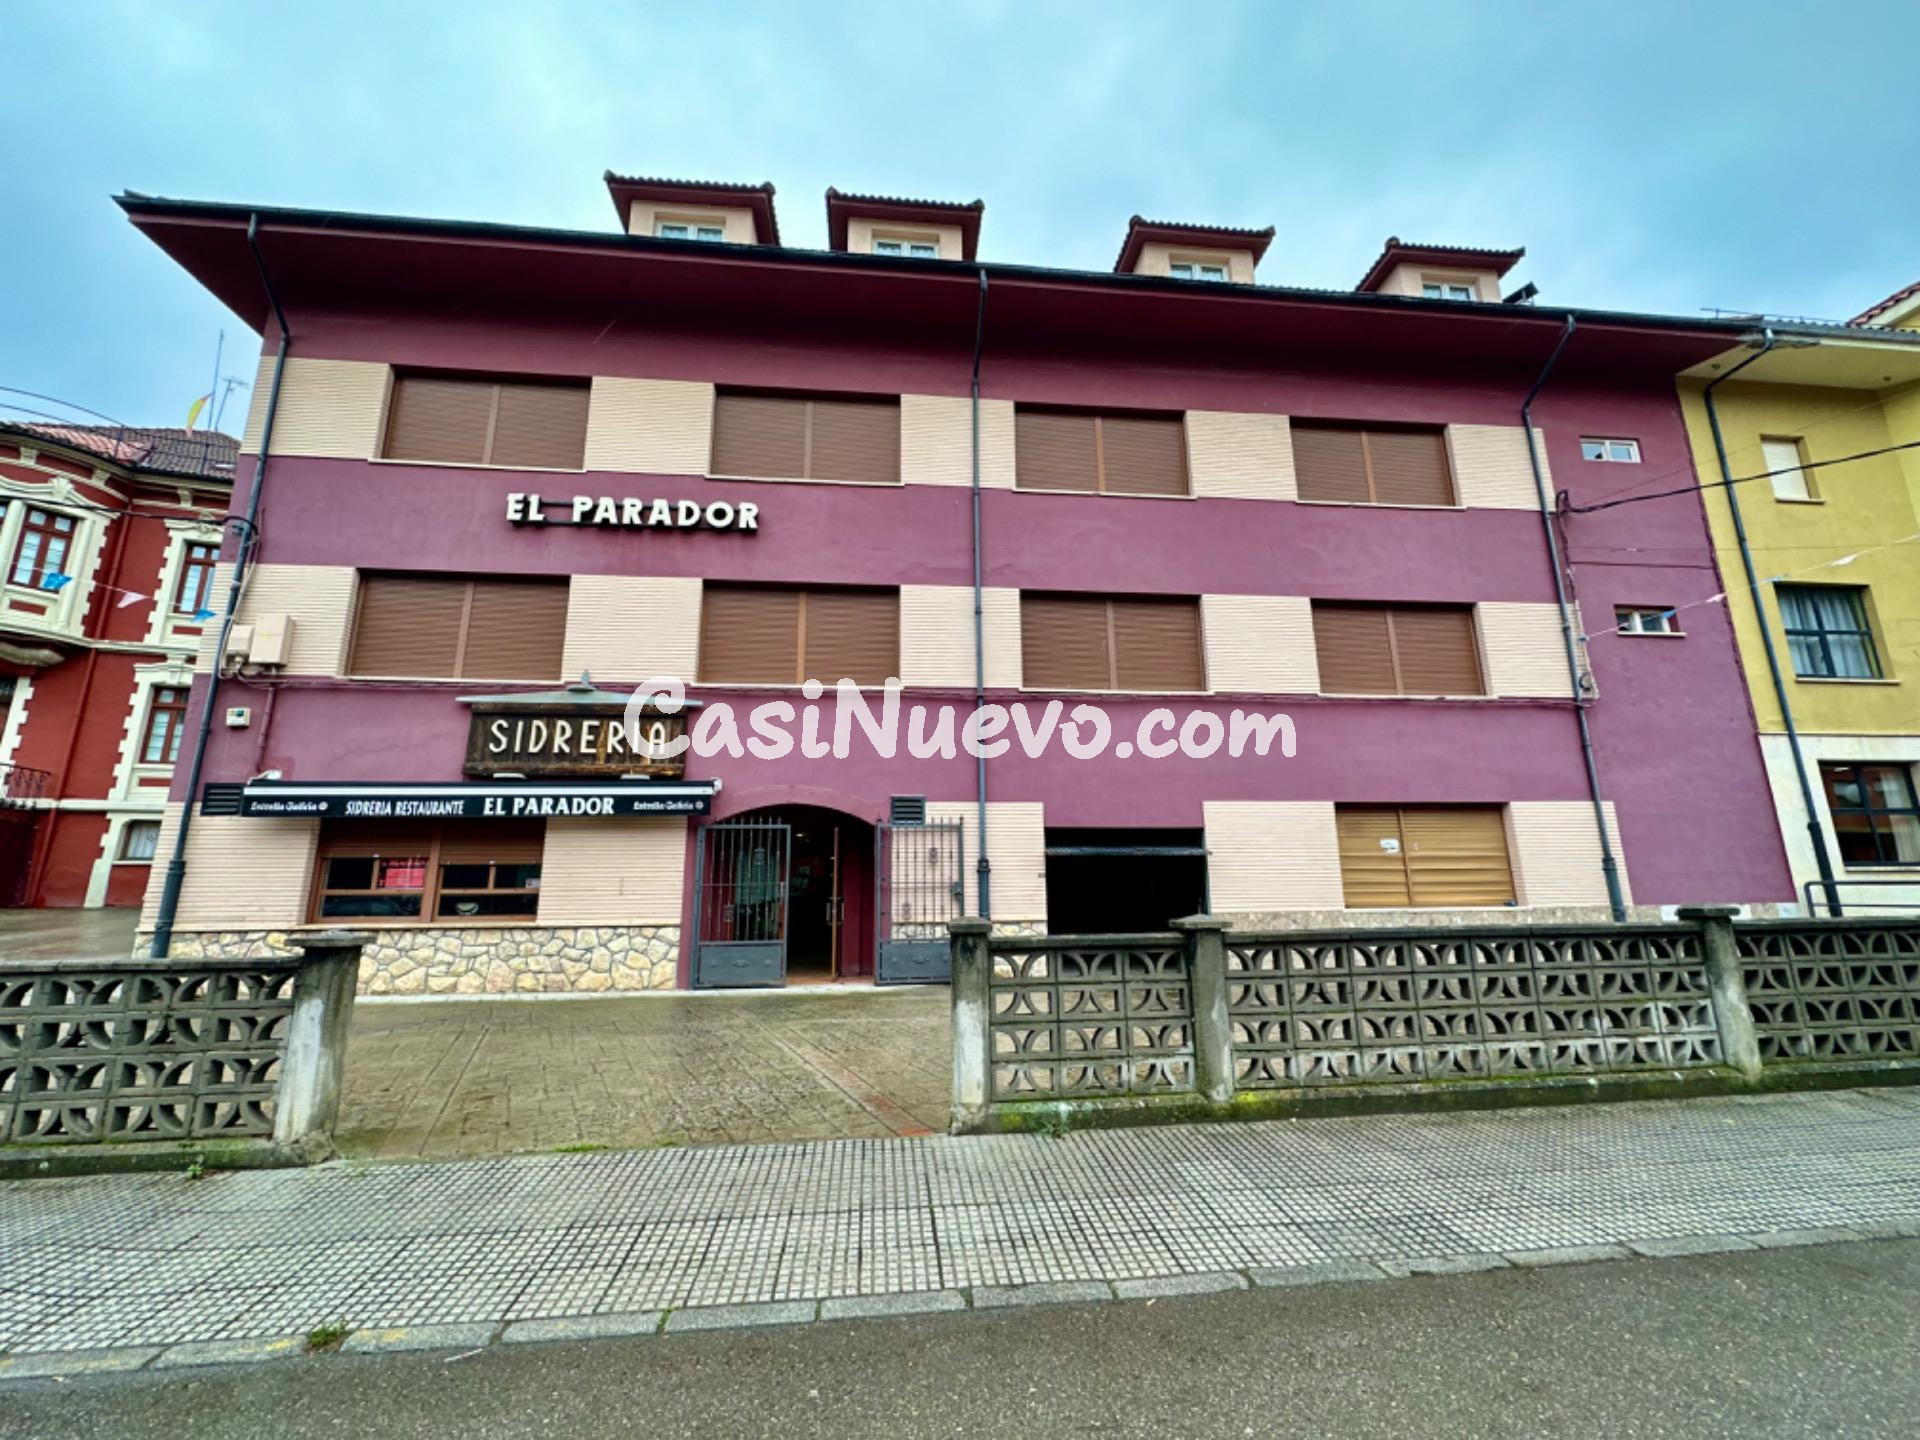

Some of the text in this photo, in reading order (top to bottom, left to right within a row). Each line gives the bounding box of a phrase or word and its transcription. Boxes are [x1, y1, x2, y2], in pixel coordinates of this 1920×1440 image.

[506, 492, 759, 529] EL PARADOR
[488, 719, 667, 754] SIDRERIA
[394, 800, 465, 816] RESTAURANTE
[483, 797, 615, 815] EL PARADOR
